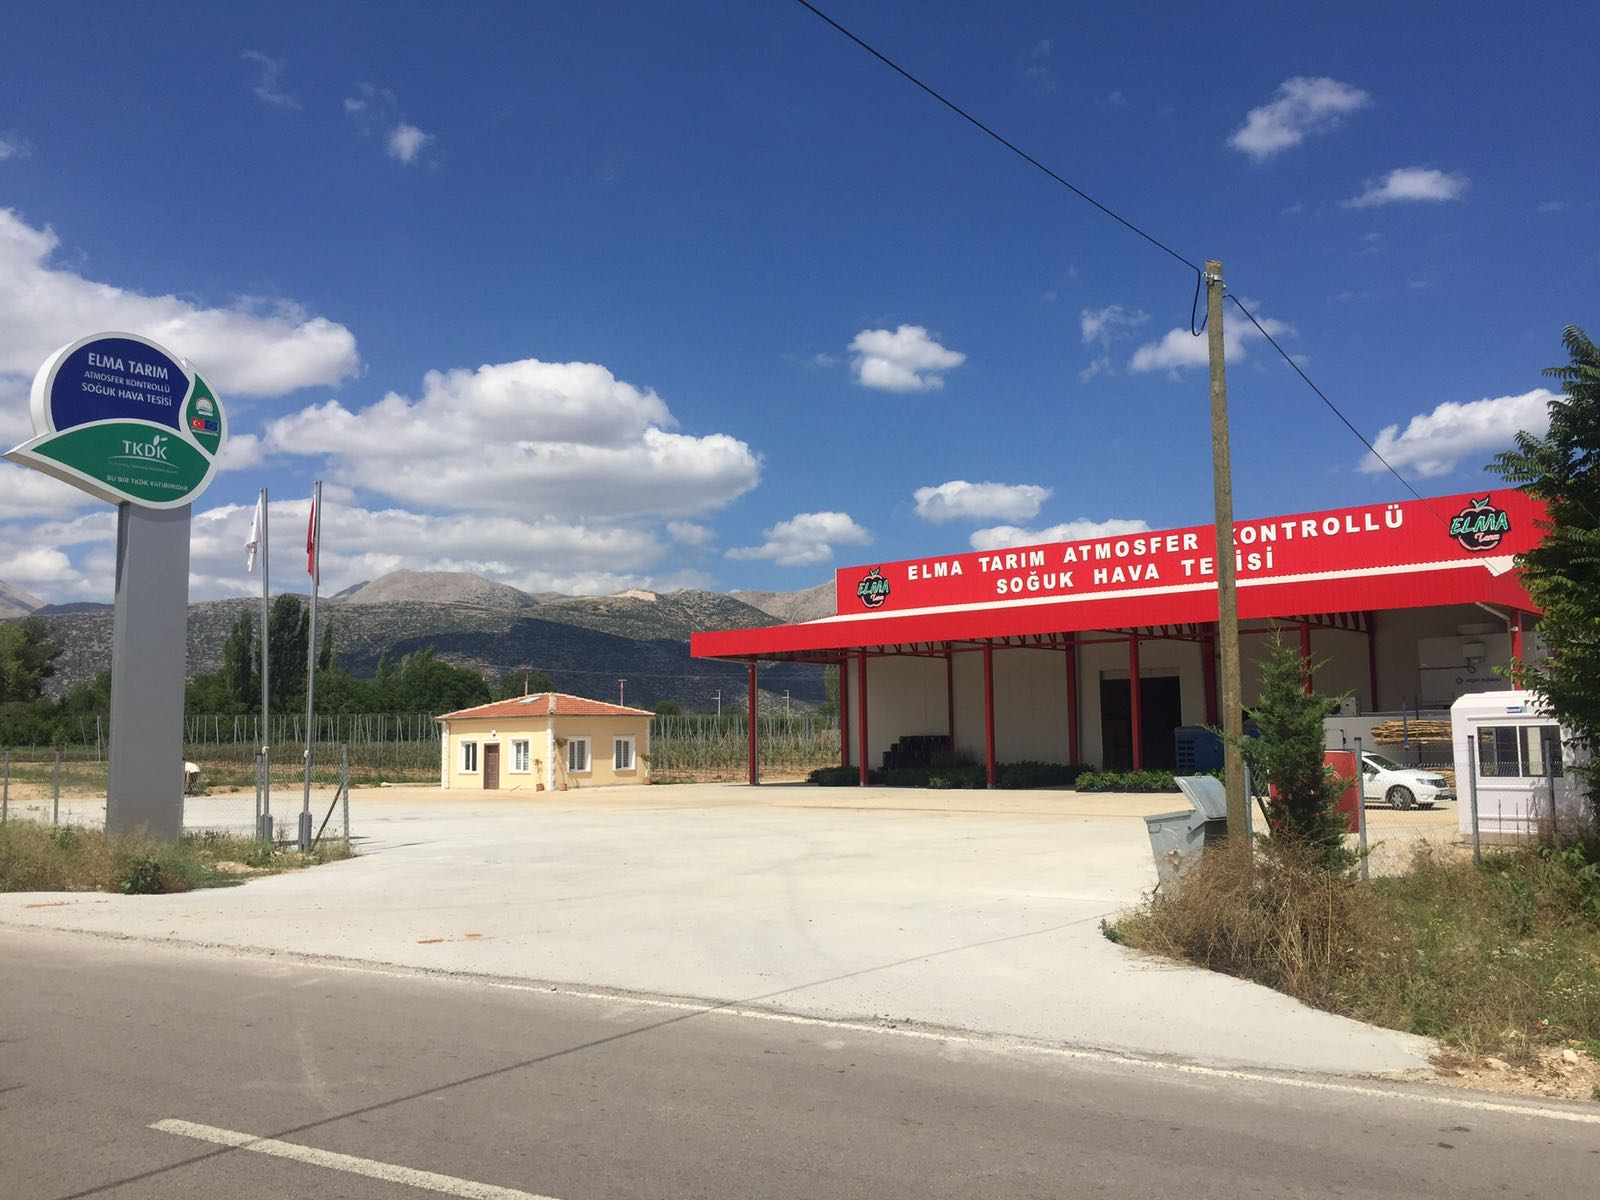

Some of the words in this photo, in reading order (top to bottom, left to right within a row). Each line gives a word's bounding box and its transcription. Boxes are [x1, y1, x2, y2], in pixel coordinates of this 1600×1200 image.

[88, 352, 125, 371] ELMA
[128, 360, 168, 380] TARIM
[81, 382, 116, 397] SOĞUK
[118, 389, 144, 402] HAVA
[146, 394, 172, 407] TESİSİ
[84, 370, 124, 385] ATMOSFER
[125, 378, 171, 394] KONTROLLÜ
[122, 440, 168, 460] TKDK
[1450, 511, 1509, 535] ELMA
[907, 560, 963, 581] ELMA
[978, 550, 1045, 573] TARIM
[1063, 533, 1199, 563] ATMOSFER
[996, 570, 1074, 595] SOĞUK
[1093, 563, 1160, 585] HAVA
[1181, 546, 1273, 576] TEİSİ
